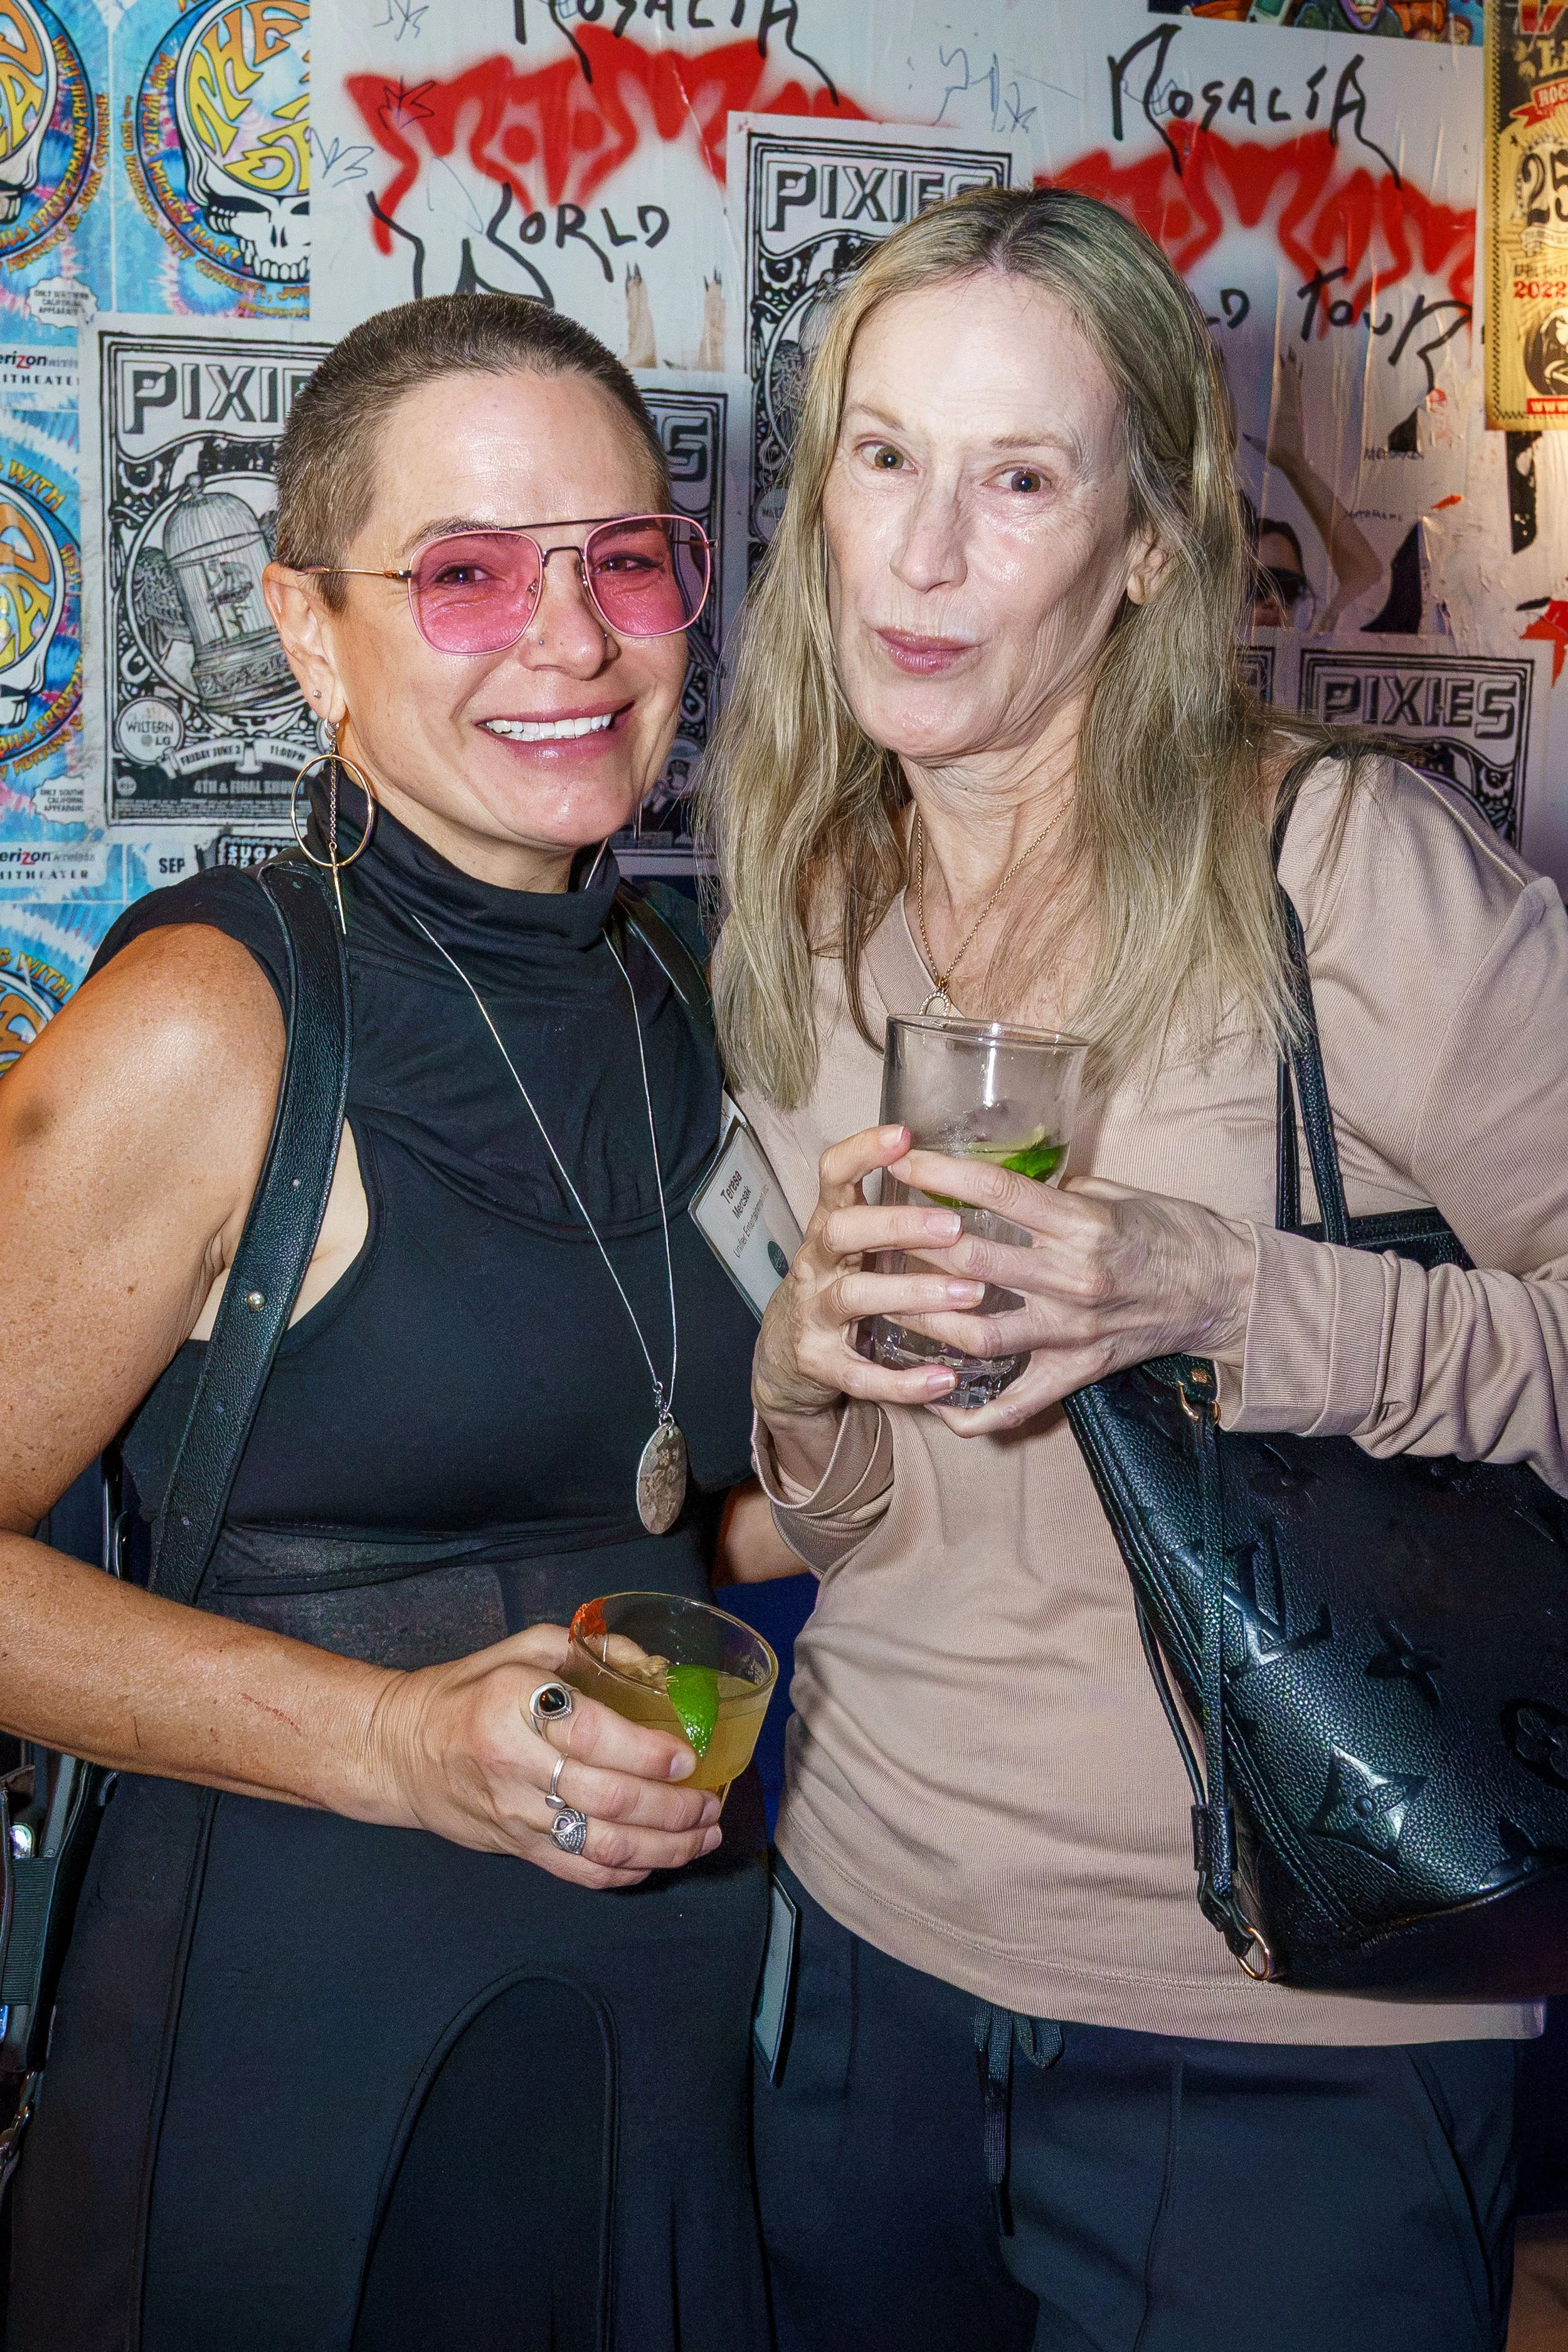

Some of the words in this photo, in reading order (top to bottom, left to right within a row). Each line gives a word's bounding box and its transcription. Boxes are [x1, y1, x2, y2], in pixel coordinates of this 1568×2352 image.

[1513, 280, 1567, 299] 2022
[1318, 673, 1518, 740] PIXIES
[126, 721, 174, 733] WILTERN
[0, 848, 50, 866] erizon
[228, 845, 280, 860] SUGA
[159, 857, 185, 873] SEP
[721, 1170, 743, 1204] Teresa
